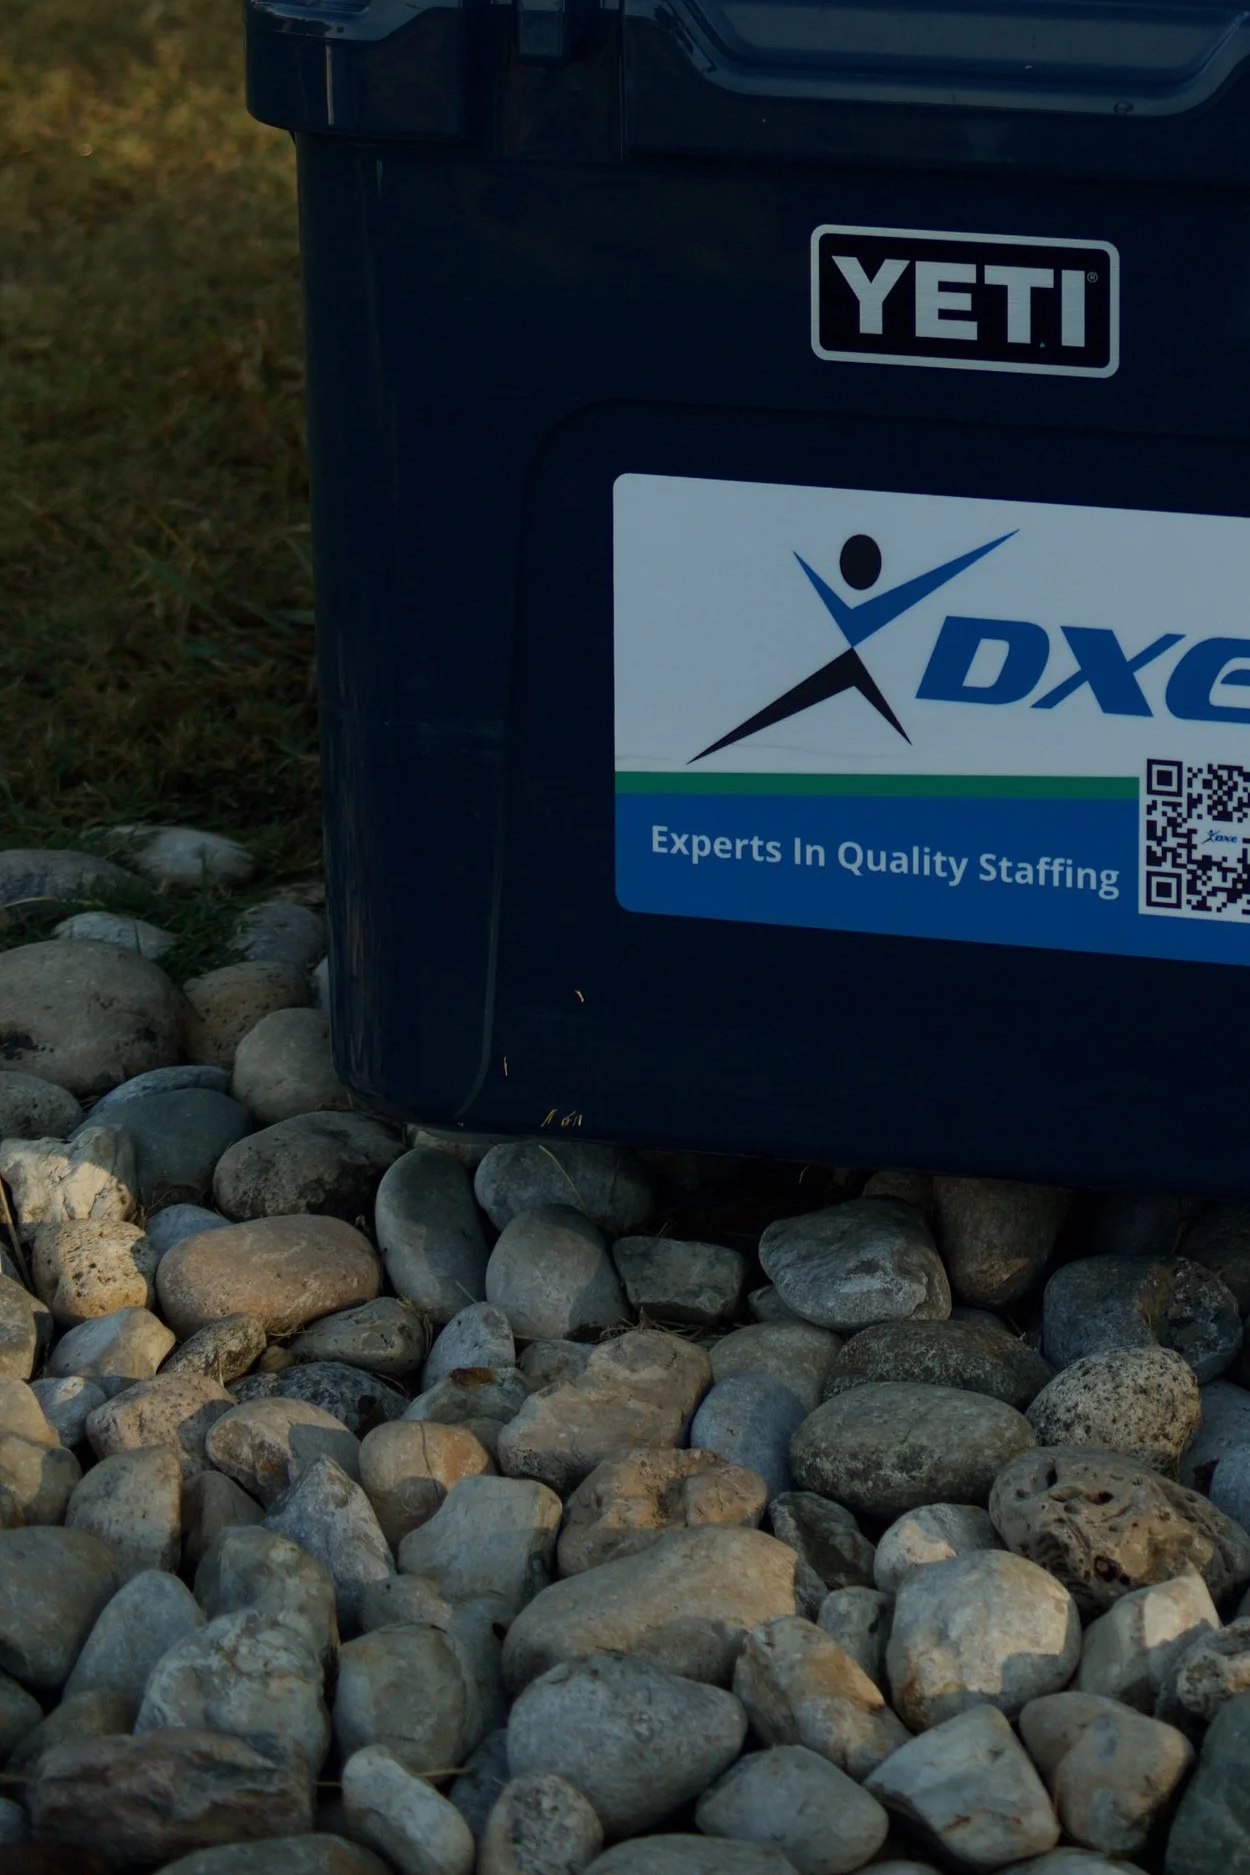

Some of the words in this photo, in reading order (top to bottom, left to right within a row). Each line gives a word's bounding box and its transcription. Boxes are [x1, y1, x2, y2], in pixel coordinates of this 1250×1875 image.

[651, 825, 783, 865] Experts
[793, 836, 825, 868] In
[837, 843, 969, 887] Quality
[977, 852, 1121, 900] Staffing
